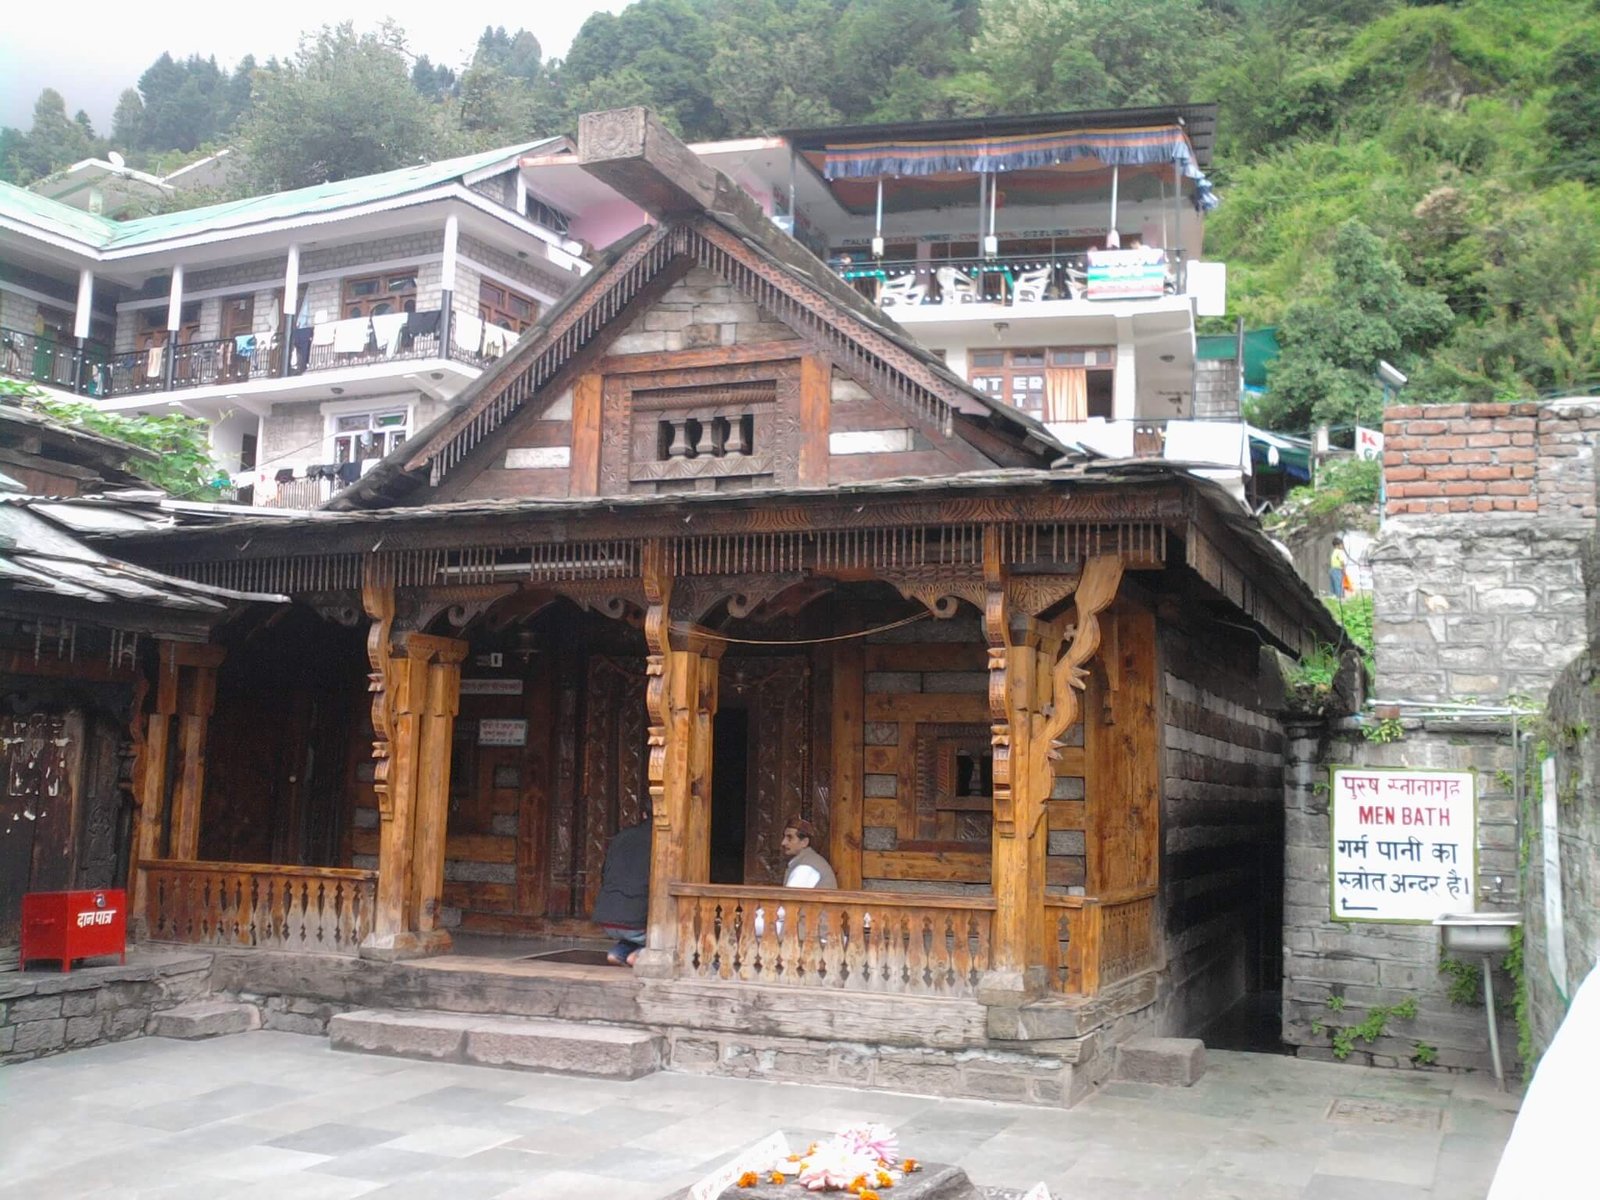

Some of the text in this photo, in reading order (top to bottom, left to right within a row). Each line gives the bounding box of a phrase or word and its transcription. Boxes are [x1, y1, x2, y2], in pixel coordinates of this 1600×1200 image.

[1359, 806, 1450, 826] MEN BATH
[1338, 834, 1459, 864] गर्म पानी का
[1390, 873, 1441, 894] अन्दर
[77, 909, 117, 928] दान पात्र
